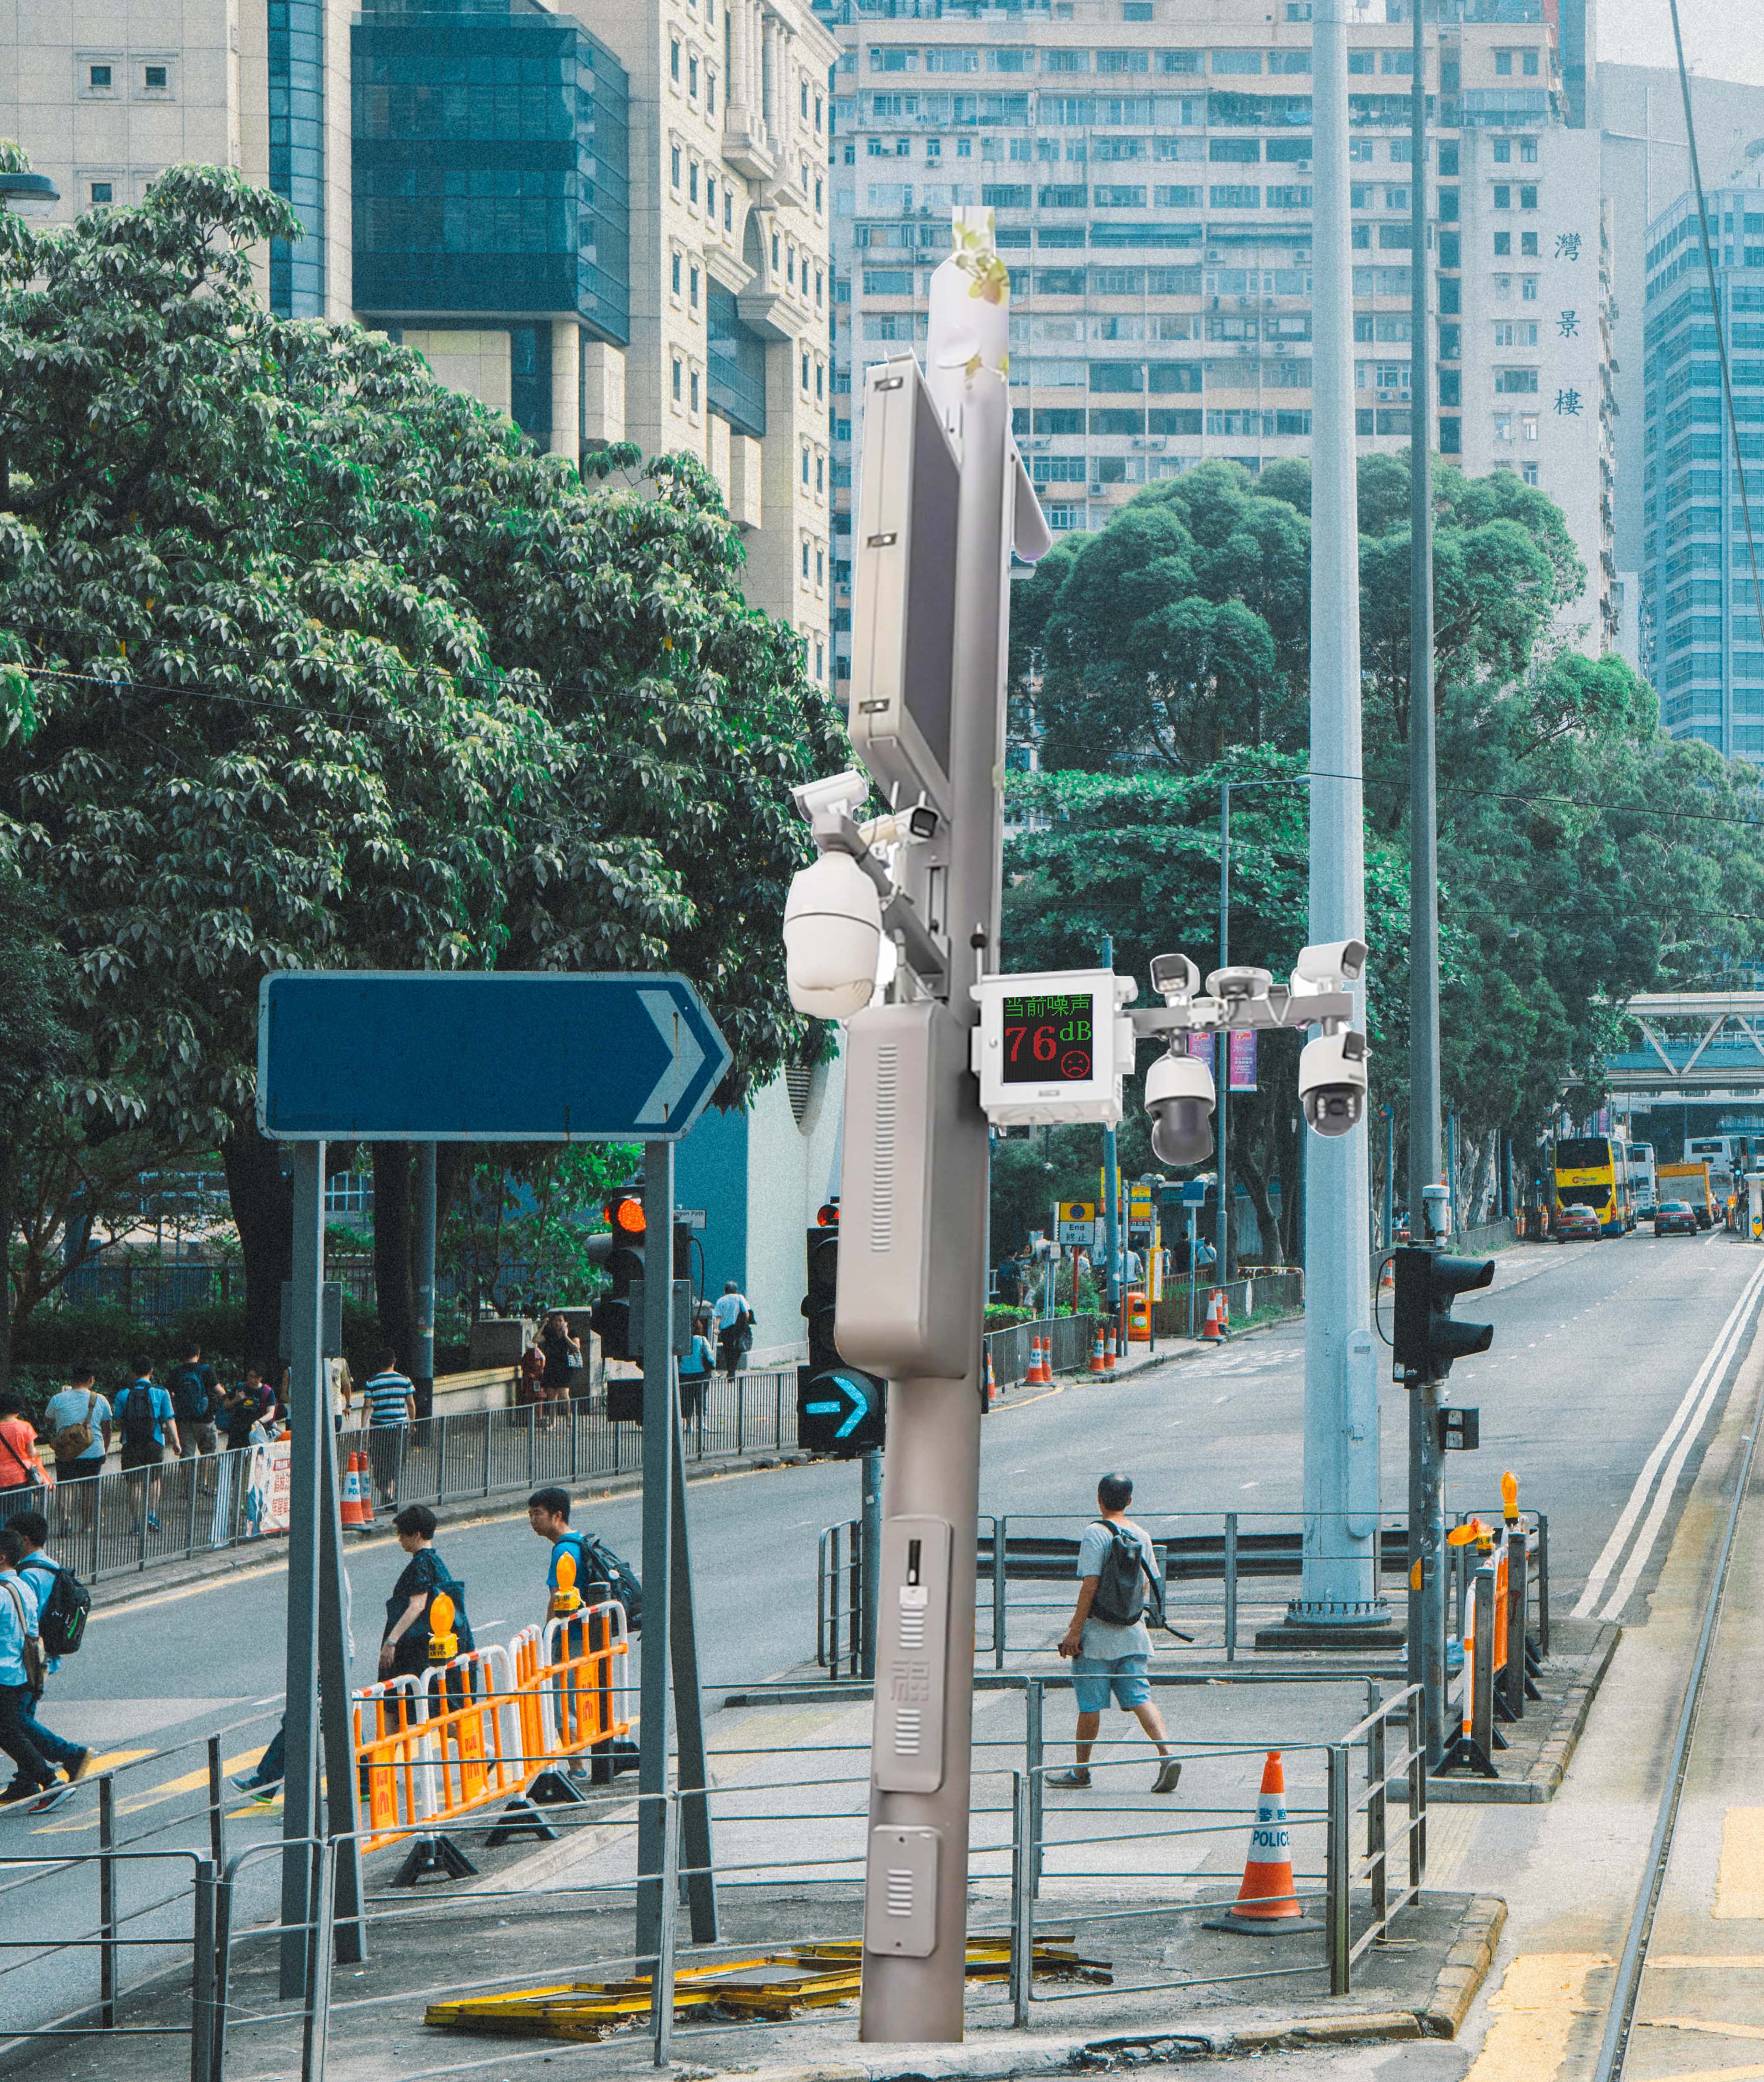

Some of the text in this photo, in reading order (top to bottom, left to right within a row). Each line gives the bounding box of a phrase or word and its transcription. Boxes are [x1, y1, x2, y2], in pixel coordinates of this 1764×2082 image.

[1553, 232, 1583, 416] 灣景樓
[1005, 994, 1092, 1018] 当前噪声
[1005, 1021, 1092, 1062] 76 dB
[1065, 1232, 1087, 1242] 終止
